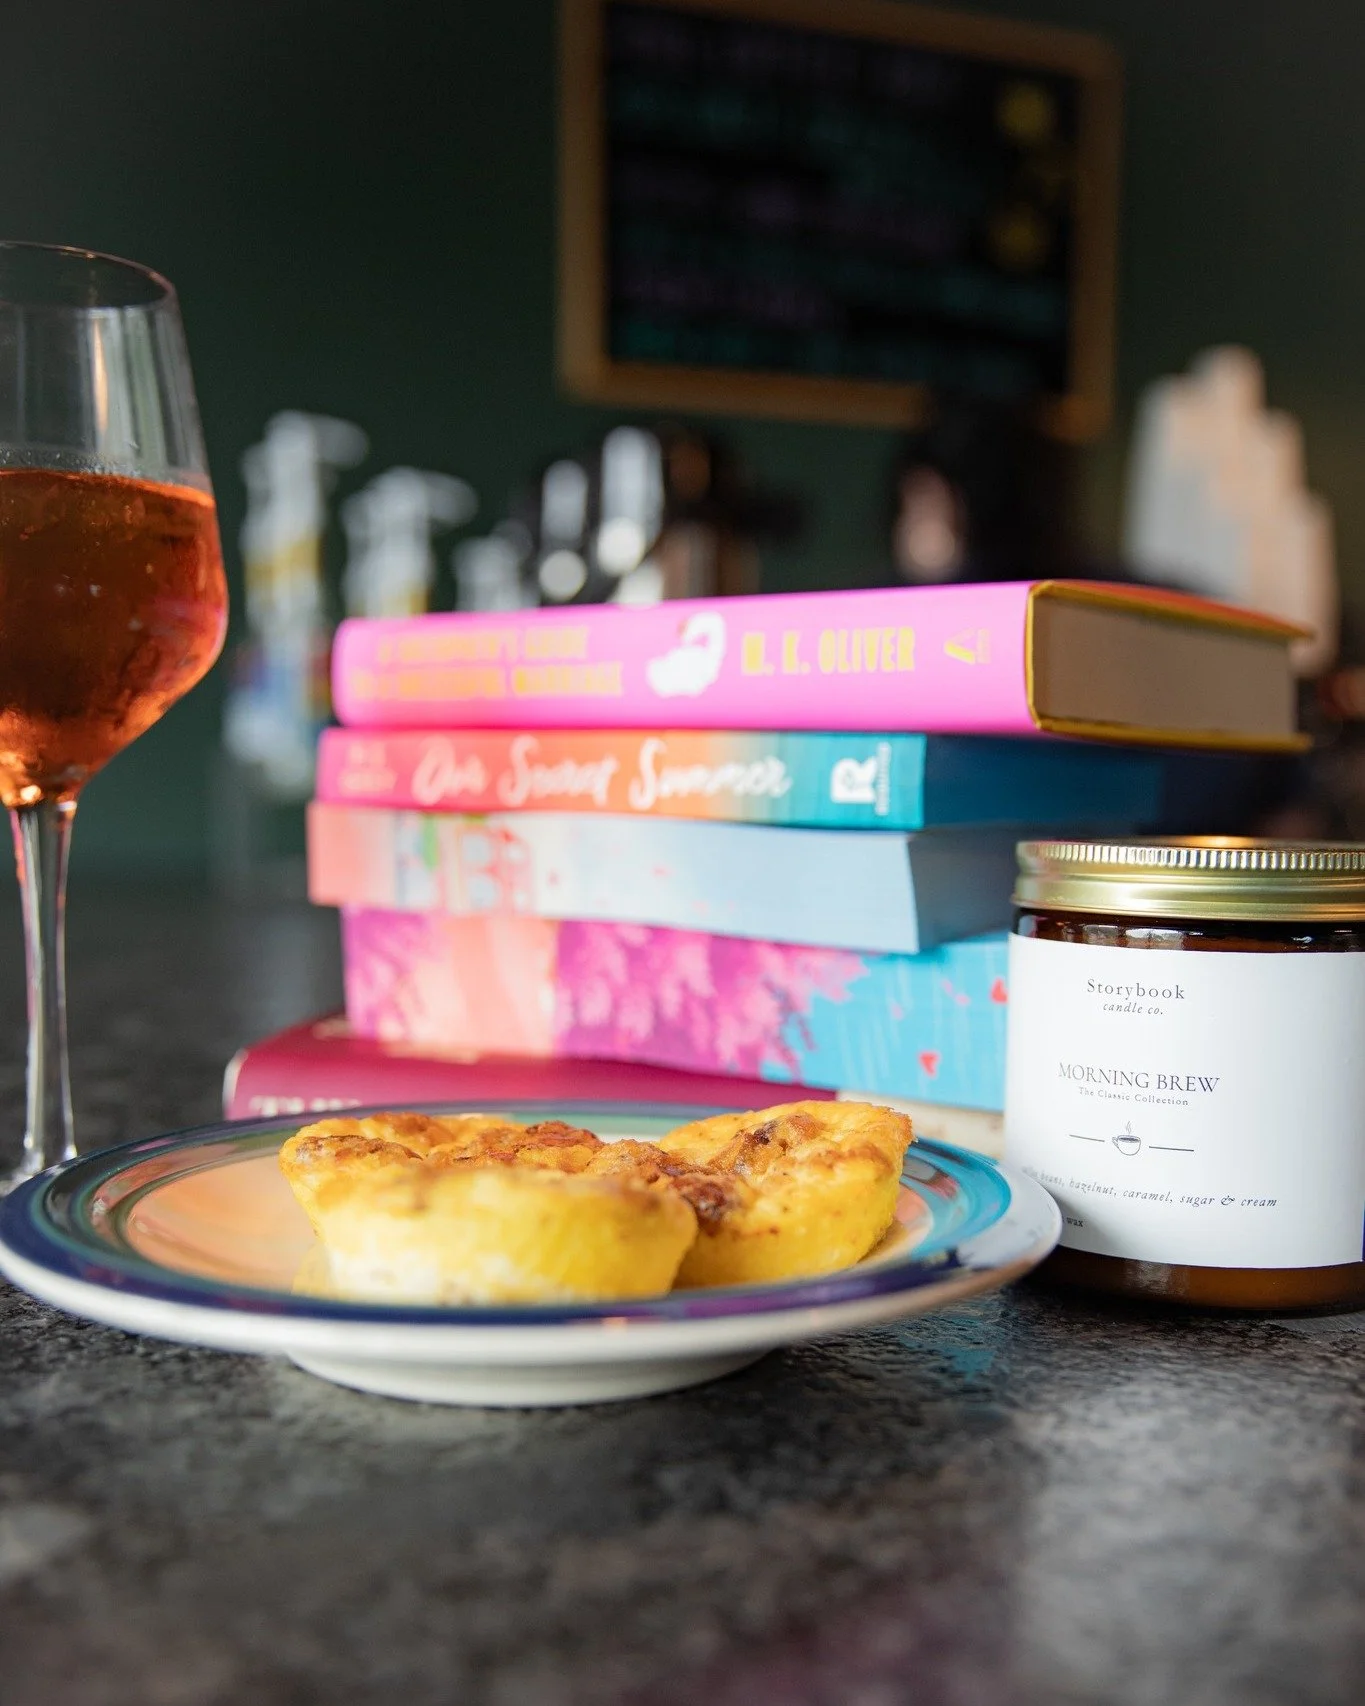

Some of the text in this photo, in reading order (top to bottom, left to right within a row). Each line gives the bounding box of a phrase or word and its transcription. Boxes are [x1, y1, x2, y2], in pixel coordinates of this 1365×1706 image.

[818, 625, 916, 675] OLIVER
[1086, 978, 1185, 1000] Storybook
[1102, 1001, 1164, 1016] candle co.
[1058, 1062, 1221, 1093] MORNING BREW
[1078, 1085, 1190, 1107] The Classic Collection
[1068, 1176, 1118, 1198] hazelnut,
[1122, 1187, 1174, 1204] caramel,
[1179, 1194, 1216, 1208] sugar
[1220, 1194, 1236, 1207] &
[1240, 1195, 1278, 1208] cream
[1065, 1216, 1084, 1228] wax
